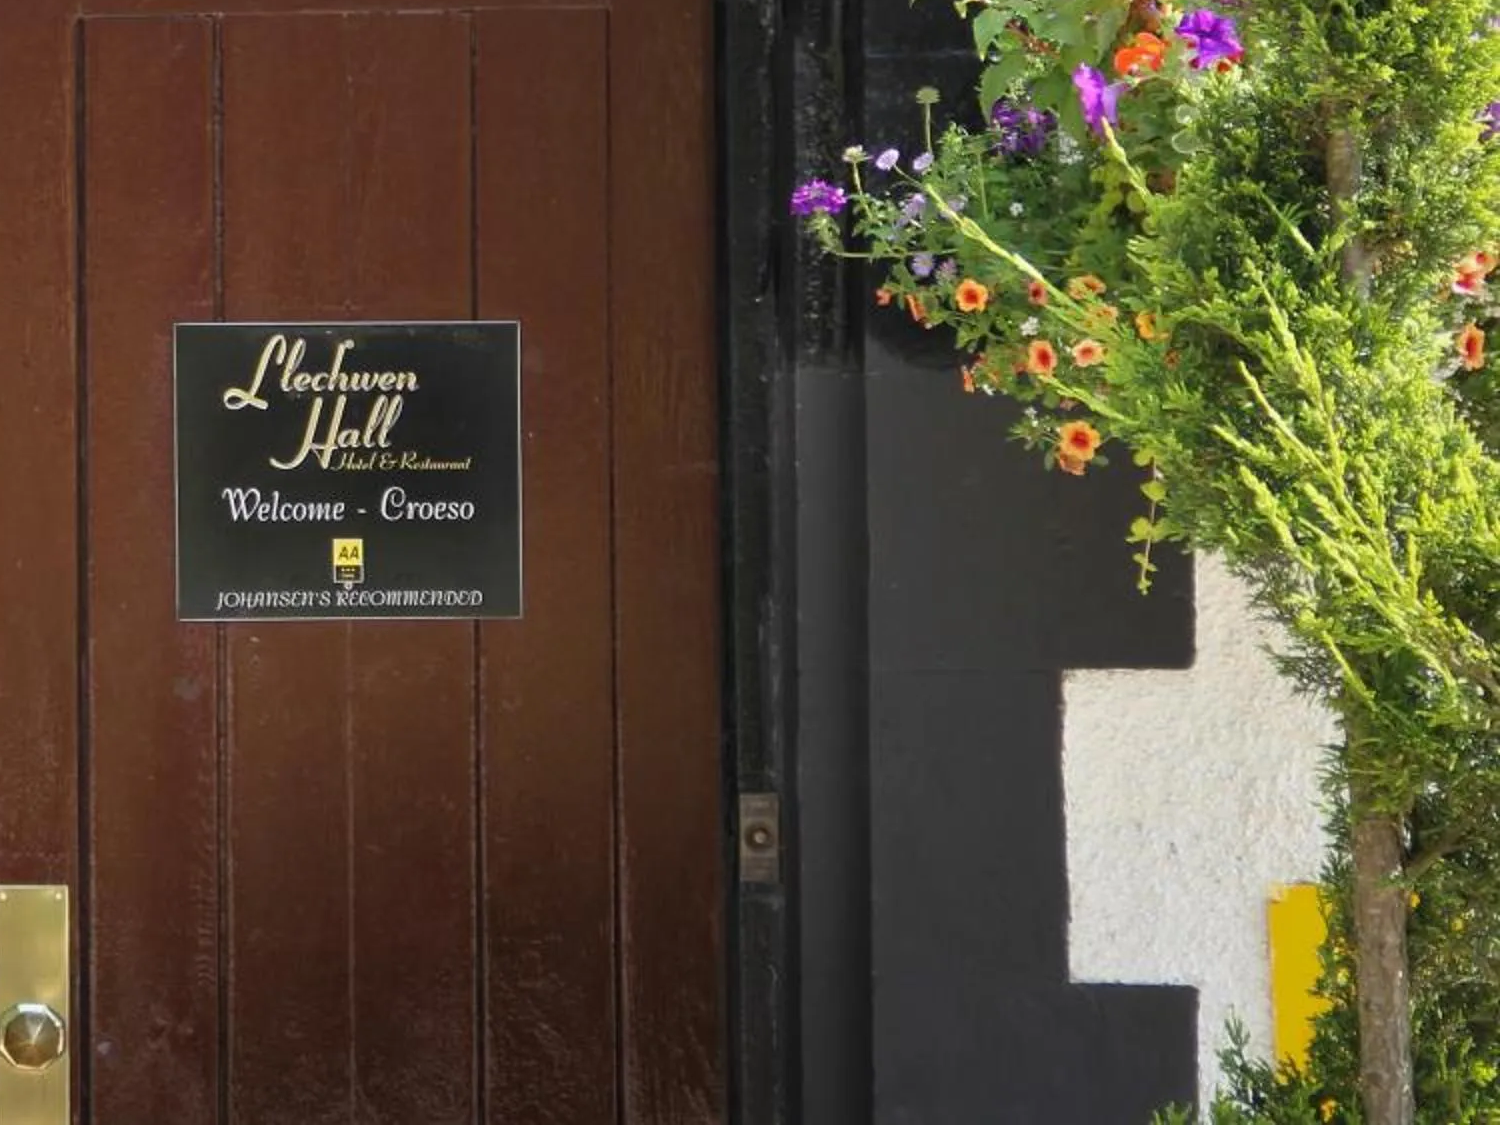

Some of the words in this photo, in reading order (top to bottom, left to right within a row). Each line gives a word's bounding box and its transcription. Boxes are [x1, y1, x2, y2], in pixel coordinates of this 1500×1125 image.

[223, 334, 420, 410] Llechwen
[269, 394, 404, 470] Hall
[331, 453, 375, 471] Hotel
[379, 453, 399, 470] &
[400, 453, 472, 471] Restaurant
[222, 488, 346, 523] Welcome
[380, 487, 476, 522] Croeso
[338, 546, 360, 561] AA
[216, 590, 332, 611] JOHANSEN'S
[336, 590, 483, 610] RECOMMENDED
